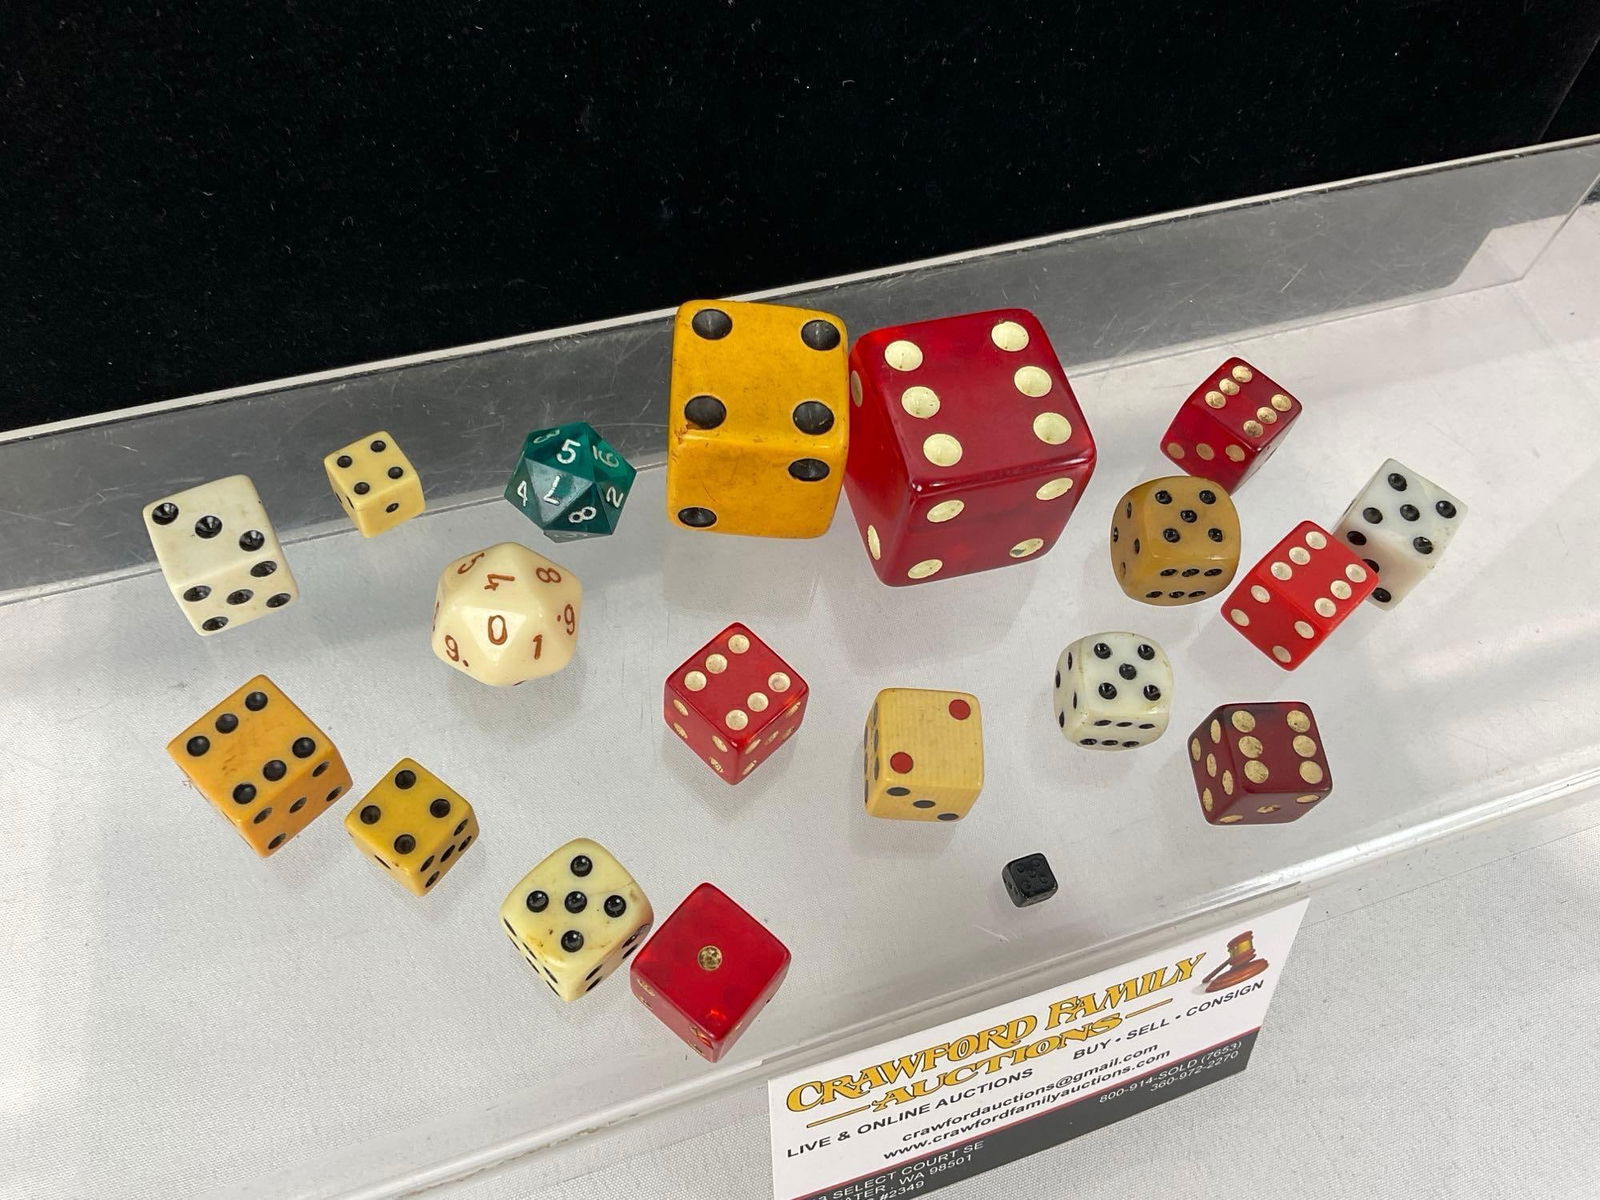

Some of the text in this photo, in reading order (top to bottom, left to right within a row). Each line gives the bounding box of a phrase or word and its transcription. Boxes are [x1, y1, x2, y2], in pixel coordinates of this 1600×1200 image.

[556, 439, 581, 465] 5
[517, 480, 528, 507] 4
[605, 486, 623, 508] 2
[568, 506, 597, 523] 8
[536, 567, 562, 583] 8
[487, 614, 508, 646] 0
[532, 633, 543, 660] 1
[786, 952, 1207, 1112] CRAWFORD FAMILY
[1073, 980, 1264, 1060] BUY SELL CONSIGN
[872, 1012, 1123, 1113] AUCTIONS
[1099, 1059, 1198, 1103] 800-914-SOLD
[1150, 1050, 1240, 1092] 360-972-2270
[884, 1050, 1171, 1160] www.crawfordfamilyauctions.com
[902, 1044, 1159, 1142] crawfordauctions@gmail.com
[786, 1068, 1034, 1158] LIVE & ONLINE AUCTIONS
[833, 1140, 985, 1199] SELECT COURT SE
[899, 1171, 925, 1185] WA
[929, 1155, 973, 1175] 98501
[879, 1180, 925, 1200] #2349
